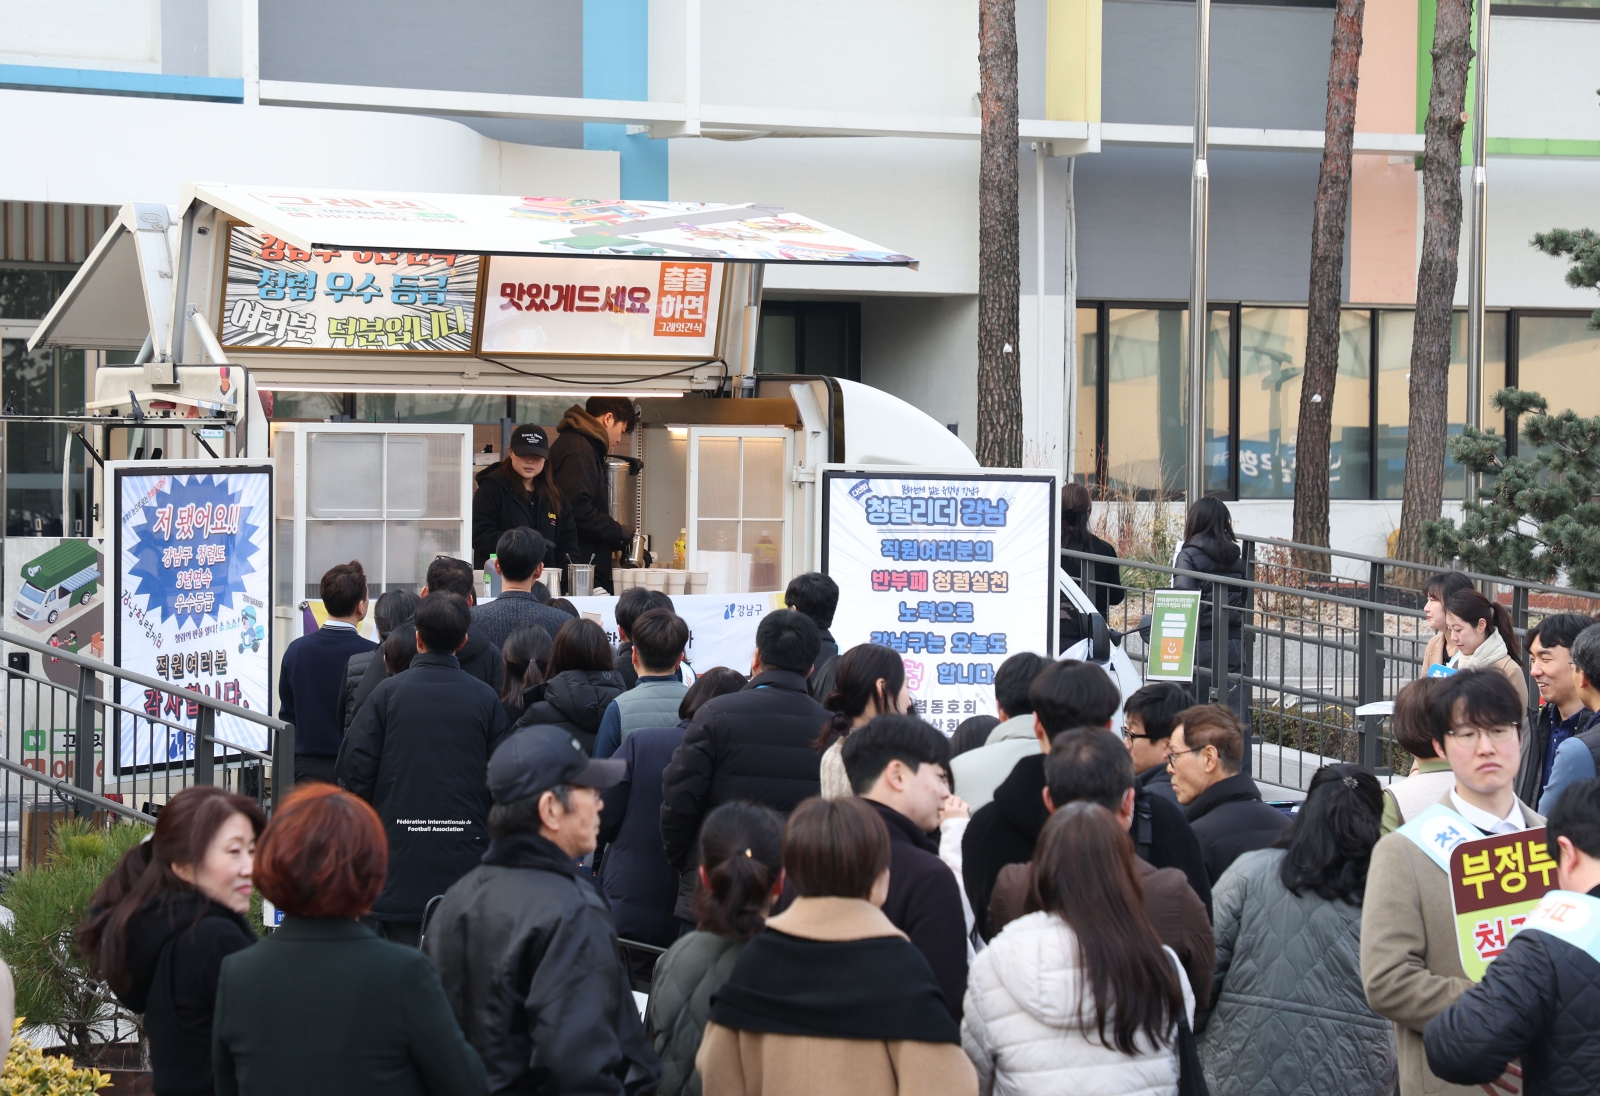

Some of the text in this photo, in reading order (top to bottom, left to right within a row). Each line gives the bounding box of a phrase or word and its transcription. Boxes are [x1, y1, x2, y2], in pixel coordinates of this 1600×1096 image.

[266, 194, 428, 211] 그레잇
[256, 269, 449, 305] 청렴 우수 등급
[663, 266, 707, 292] 출출
[499, 282, 651, 314] 맛있게드세요
[660, 294, 704, 320] 하면
[230, 299, 468, 346] 여러분 덕분입니다
[657, 321, 703, 333] 그레잇간식
[928, 486, 940, 496] 없는
[962, 486, 980, 496] 강남구
[153, 503, 174, 542] 저
[175, 502, 240, 540] 됐어요!!
[865, 495, 1009, 527] 청렴리더 강남
[162, 544, 226, 568] 강남구 청렴도
[881, 539, 993, 562] 직원여러분의
[176, 569, 212, 590] 3년연속
[871, 570, 1009, 593] 반부패 청렴실천
[174, 592, 215, 615] 우수등급
[737, 604, 763, 617] 강남구
[898, 601, 974, 622] 노력으로
[871, 631, 1007, 654] 강남구는 오늘도
[156, 650, 228, 680] 직원여러분
[1461, 841, 1559, 900] 부정부
